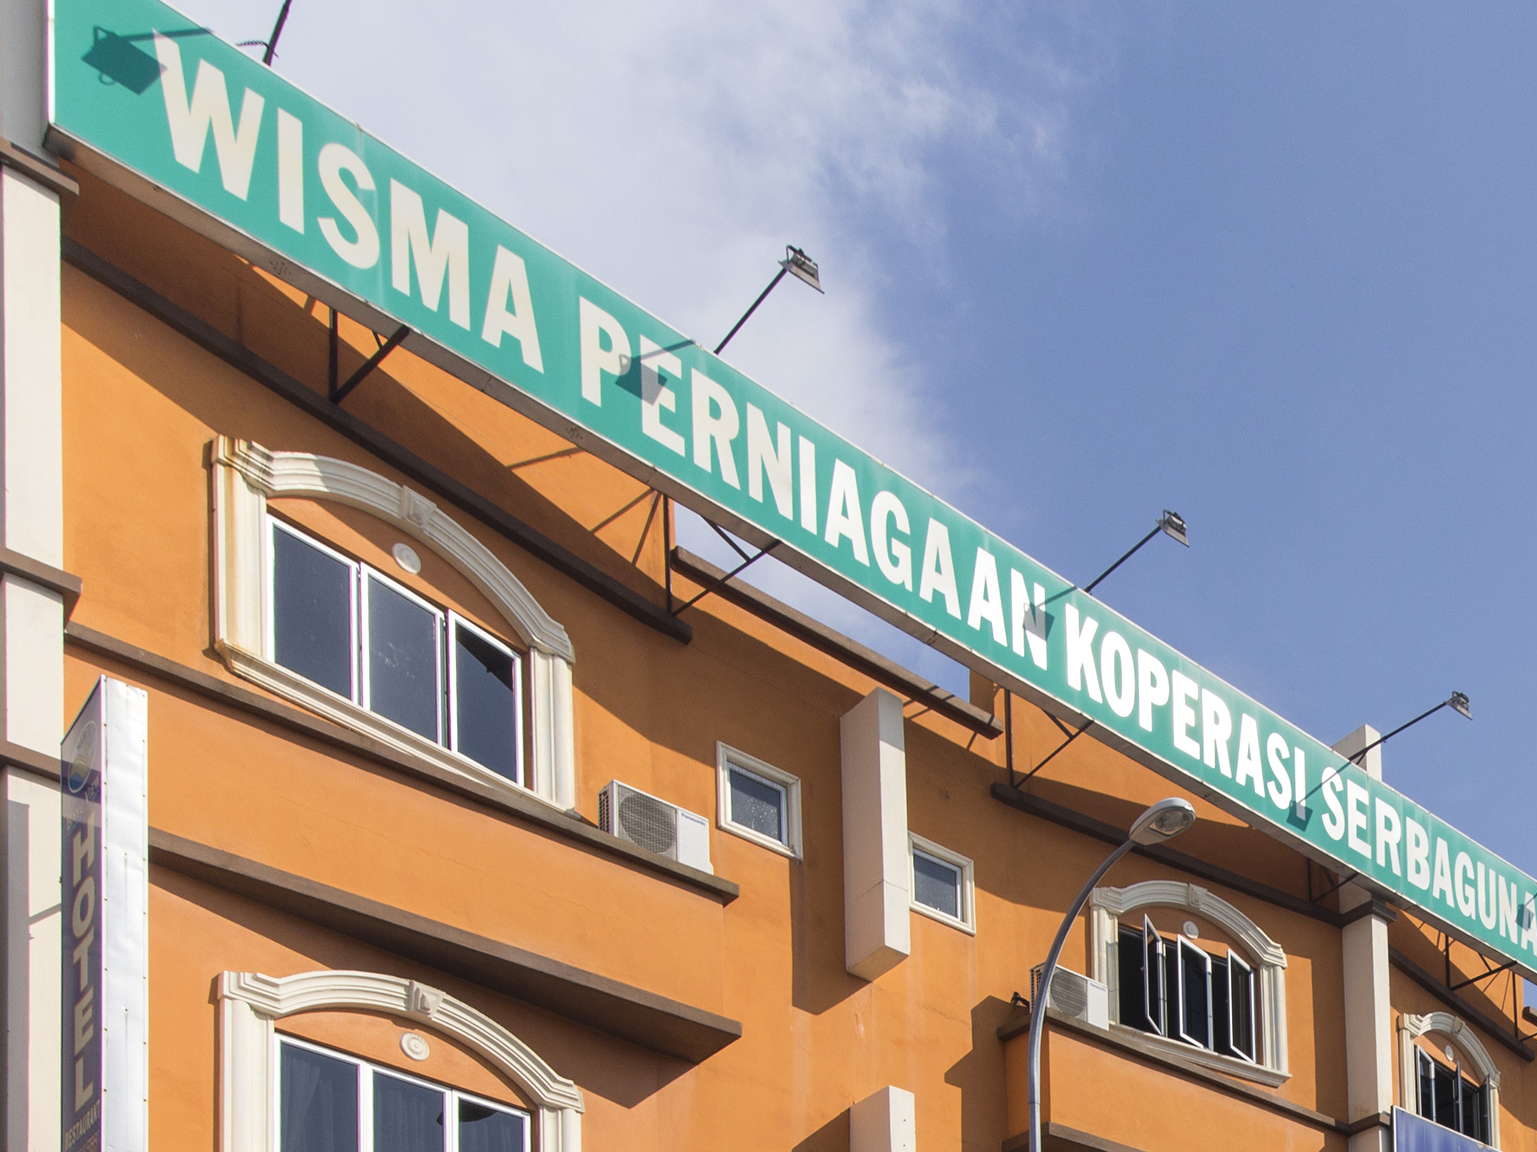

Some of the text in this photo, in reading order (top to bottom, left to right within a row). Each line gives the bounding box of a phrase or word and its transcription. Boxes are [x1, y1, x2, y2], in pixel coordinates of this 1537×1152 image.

[153, 28, 544, 374] WISMA
[579, 295, 1047, 671] PERNIAGAAN
[1064, 602, 1306, 821] KOPERASI
[72, 808, 96, 1114] HOTEL
